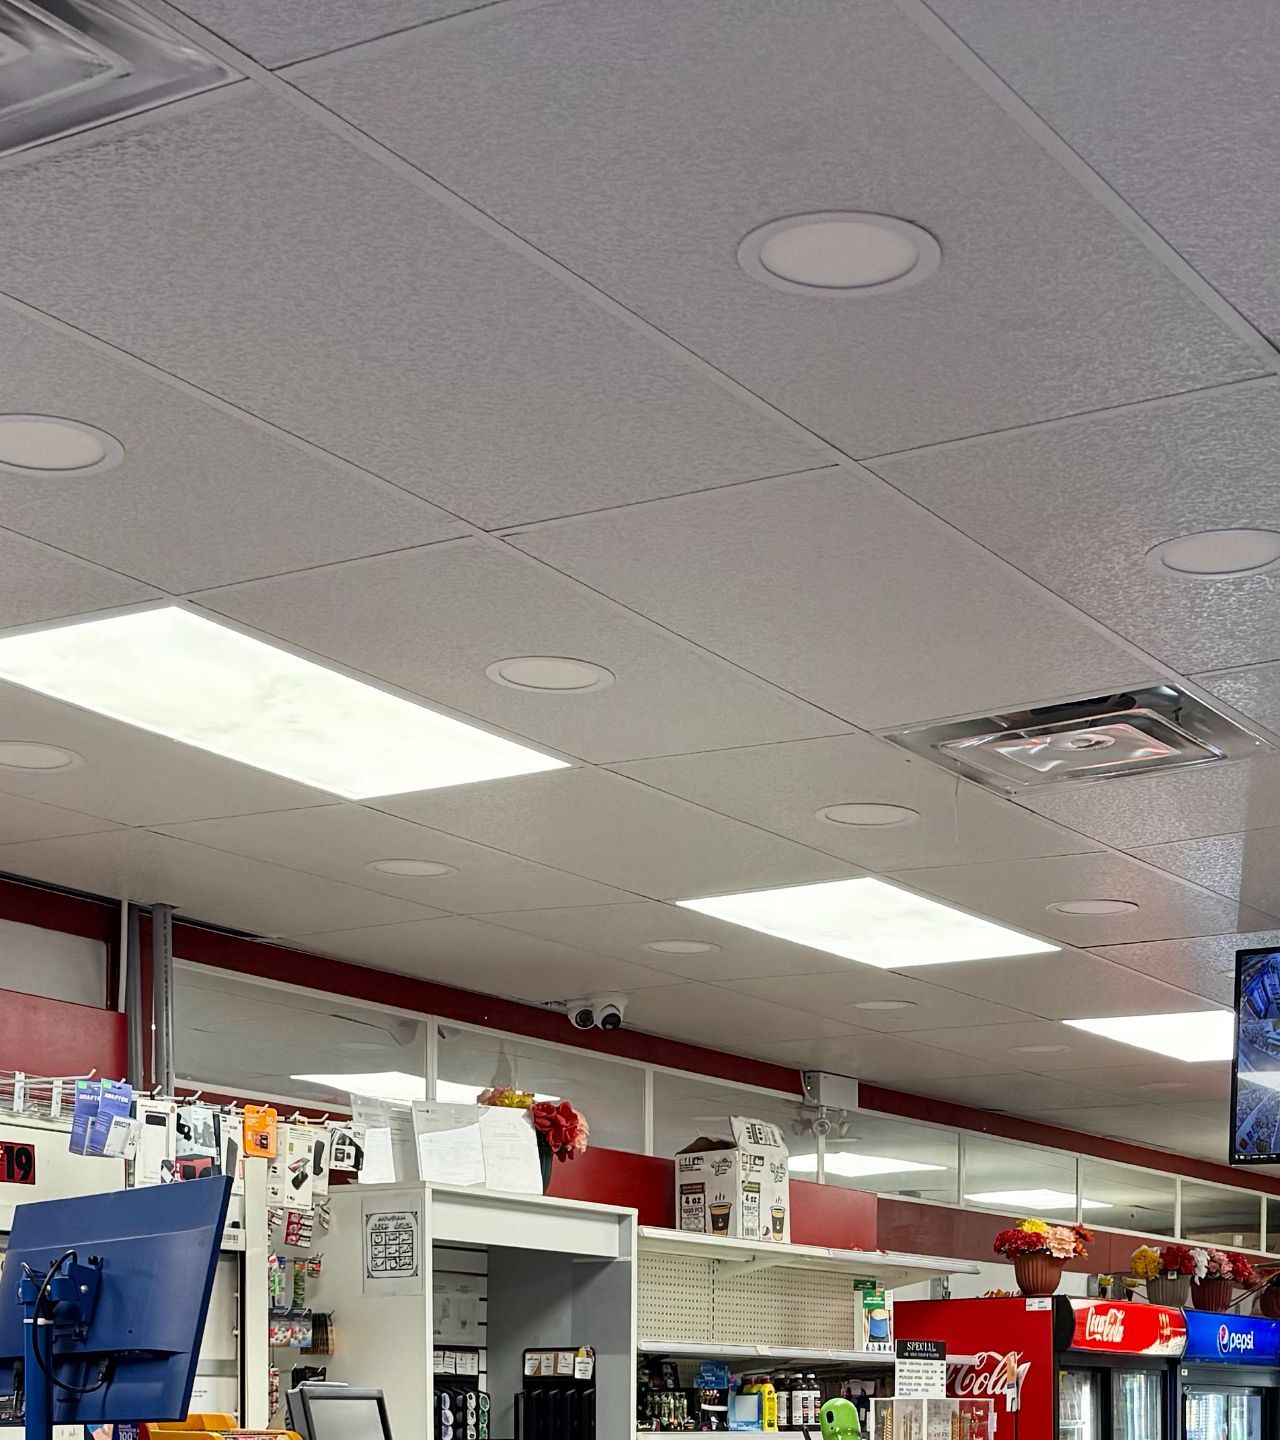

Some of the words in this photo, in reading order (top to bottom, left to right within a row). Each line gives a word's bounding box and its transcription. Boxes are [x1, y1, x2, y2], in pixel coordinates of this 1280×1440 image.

[4, 1145, 34, 1182] 19
[906, 1341, 937, 1351] SPECIAL
[1229, 1327, 1255, 1351] pepsi
